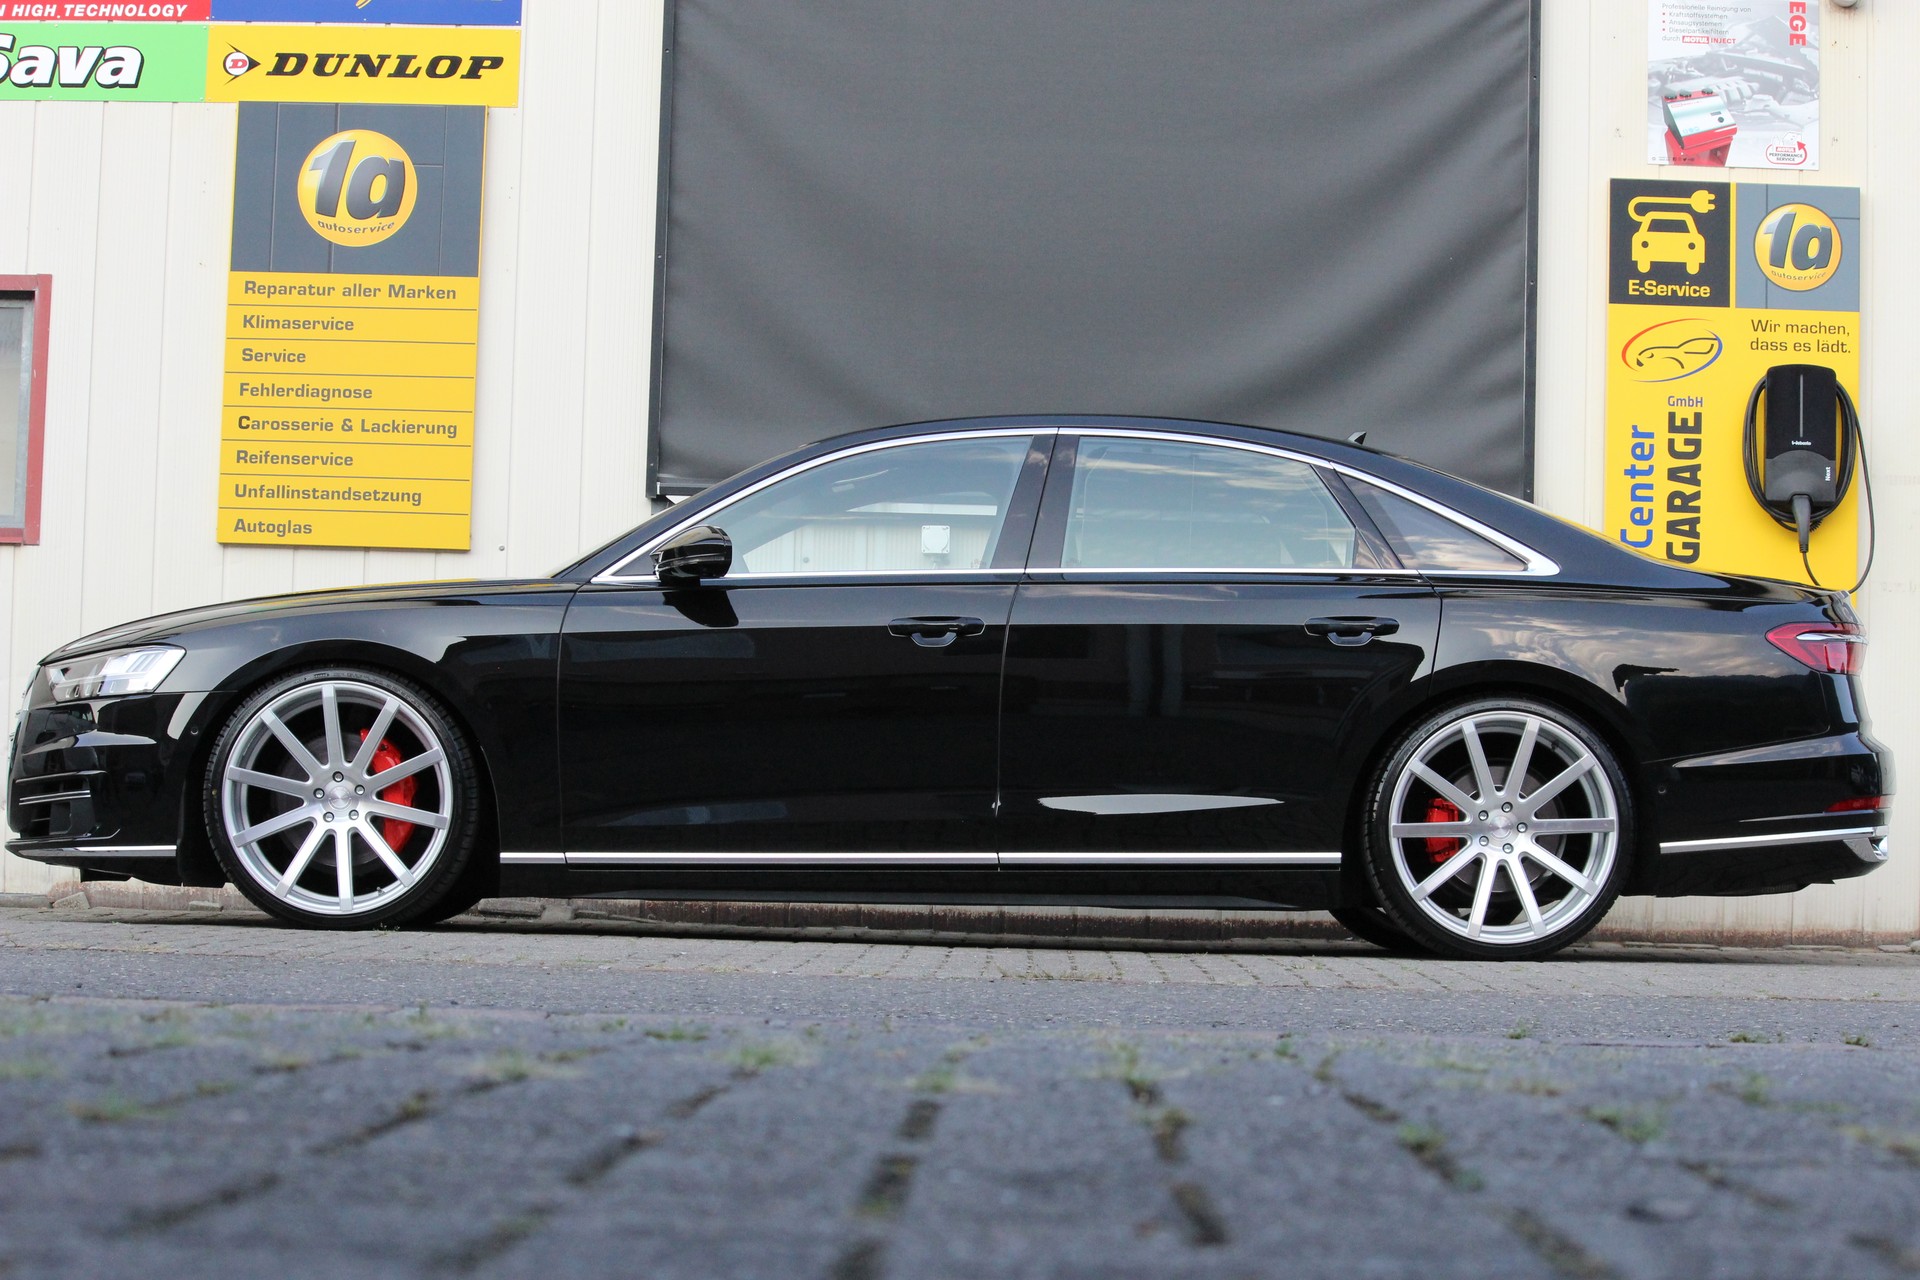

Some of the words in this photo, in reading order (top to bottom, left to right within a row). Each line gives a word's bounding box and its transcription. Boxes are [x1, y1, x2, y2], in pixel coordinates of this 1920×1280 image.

[12, 4, 57, 17] HIGH
[64, 4, 187, 17] TECHNOLOGY
[1662, 3, 1705, 11] Professionelle
[1707, 5, 1739, 13] Reinigung
[1668, 12, 1728, 20] Kraftstoffsystemen
[266, 52, 504, 80] DUNLOP
[309, 139, 406, 221] 1a
[317, 220, 395, 234] autoservice
[1764, 211, 1833, 271] 1a
[1771, 270, 1827, 281] autoservice
[244, 280, 335, 297] Reparatur
[342, 283, 381, 298] aller
[388, 284, 457, 300] Marken
[1628, 279, 1711, 298] E-Service
[243, 315, 354, 331] Klimaservice
[1751, 319, 1780, 333] Wir
[1785, 321, 1850, 336] machen,
[1750, 337, 1787, 351] dass
[1793, 341, 1811, 352] es
[1816, 337, 1851, 353] lädt.
[241, 348, 306, 364] Service
[239, 382, 373, 402] Fehlerdiagnose
[1667, 395, 1703, 408] GmbH
[238, 415, 334, 432] Carosserie
[341, 418, 353, 432] &
[360, 418, 458, 439] Lackierung
[236, 450, 354, 467] Reifenservice
[234, 483, 422, 507] Unfallinstandsetzung
[1620, 424, 1655, 548] Center
[1666, 411, 1702, 564] GARAGE
[233, 518, 313, 537] Autoglas
